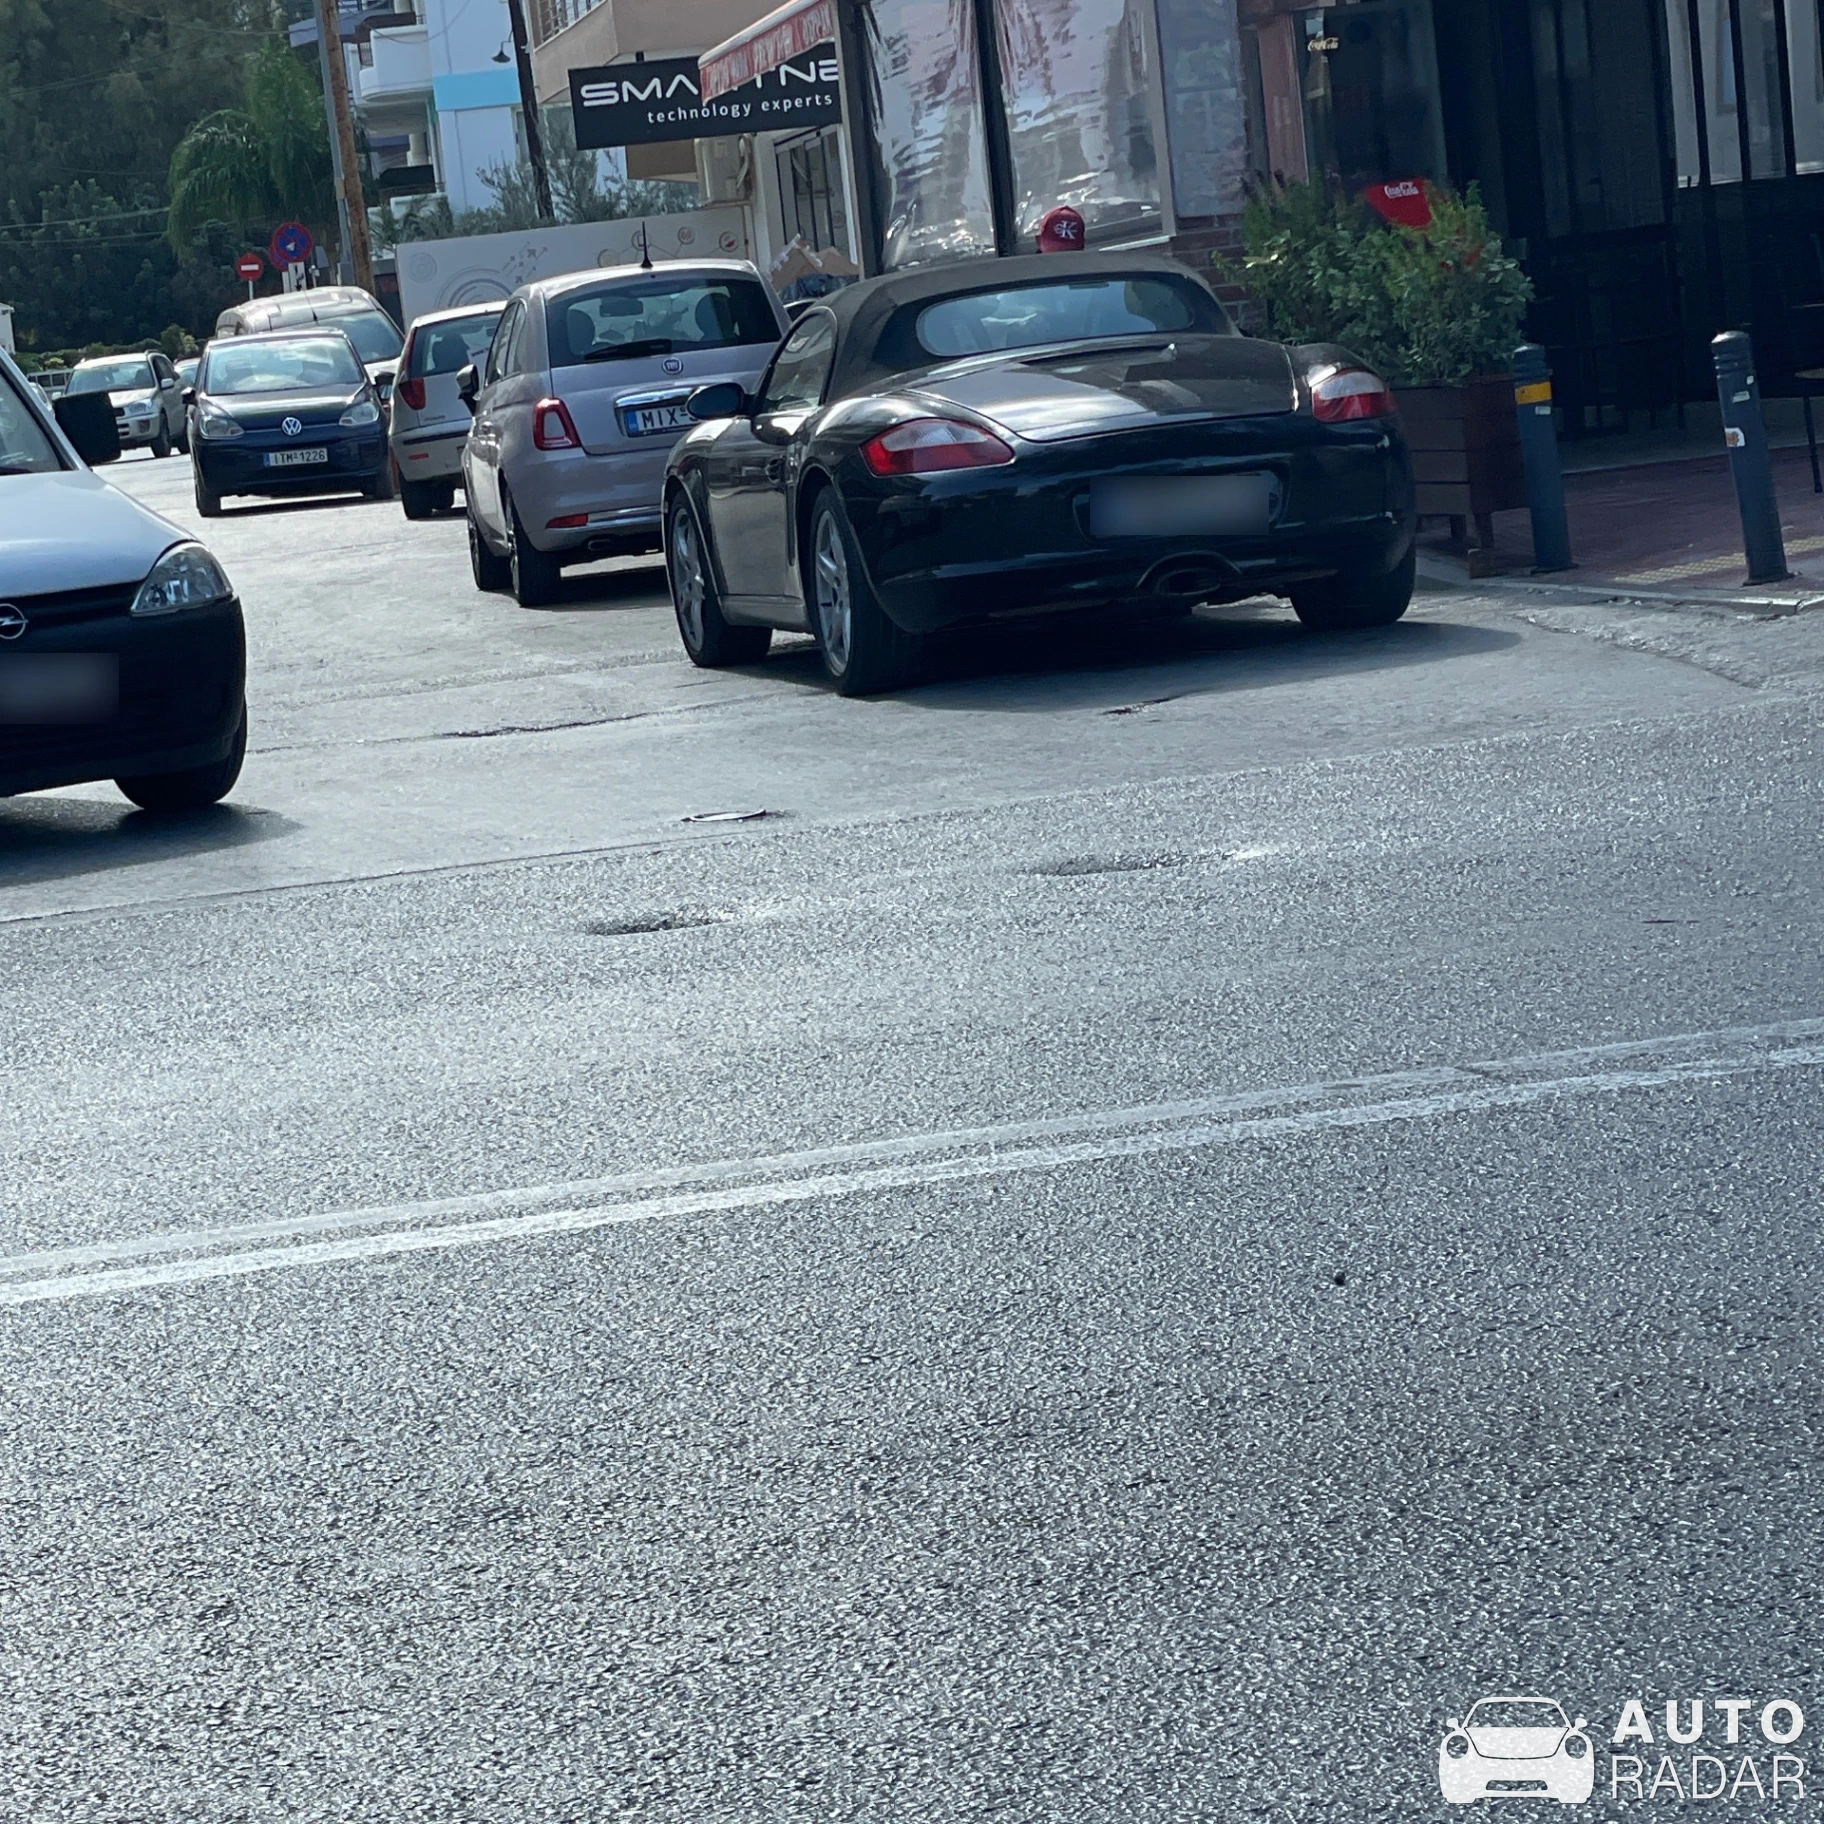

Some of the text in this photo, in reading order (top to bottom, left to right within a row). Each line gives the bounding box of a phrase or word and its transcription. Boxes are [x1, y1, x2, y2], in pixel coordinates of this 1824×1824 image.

[580, 58, 839, 107] SMANE
[647, 93, 833, 124] technology experts
